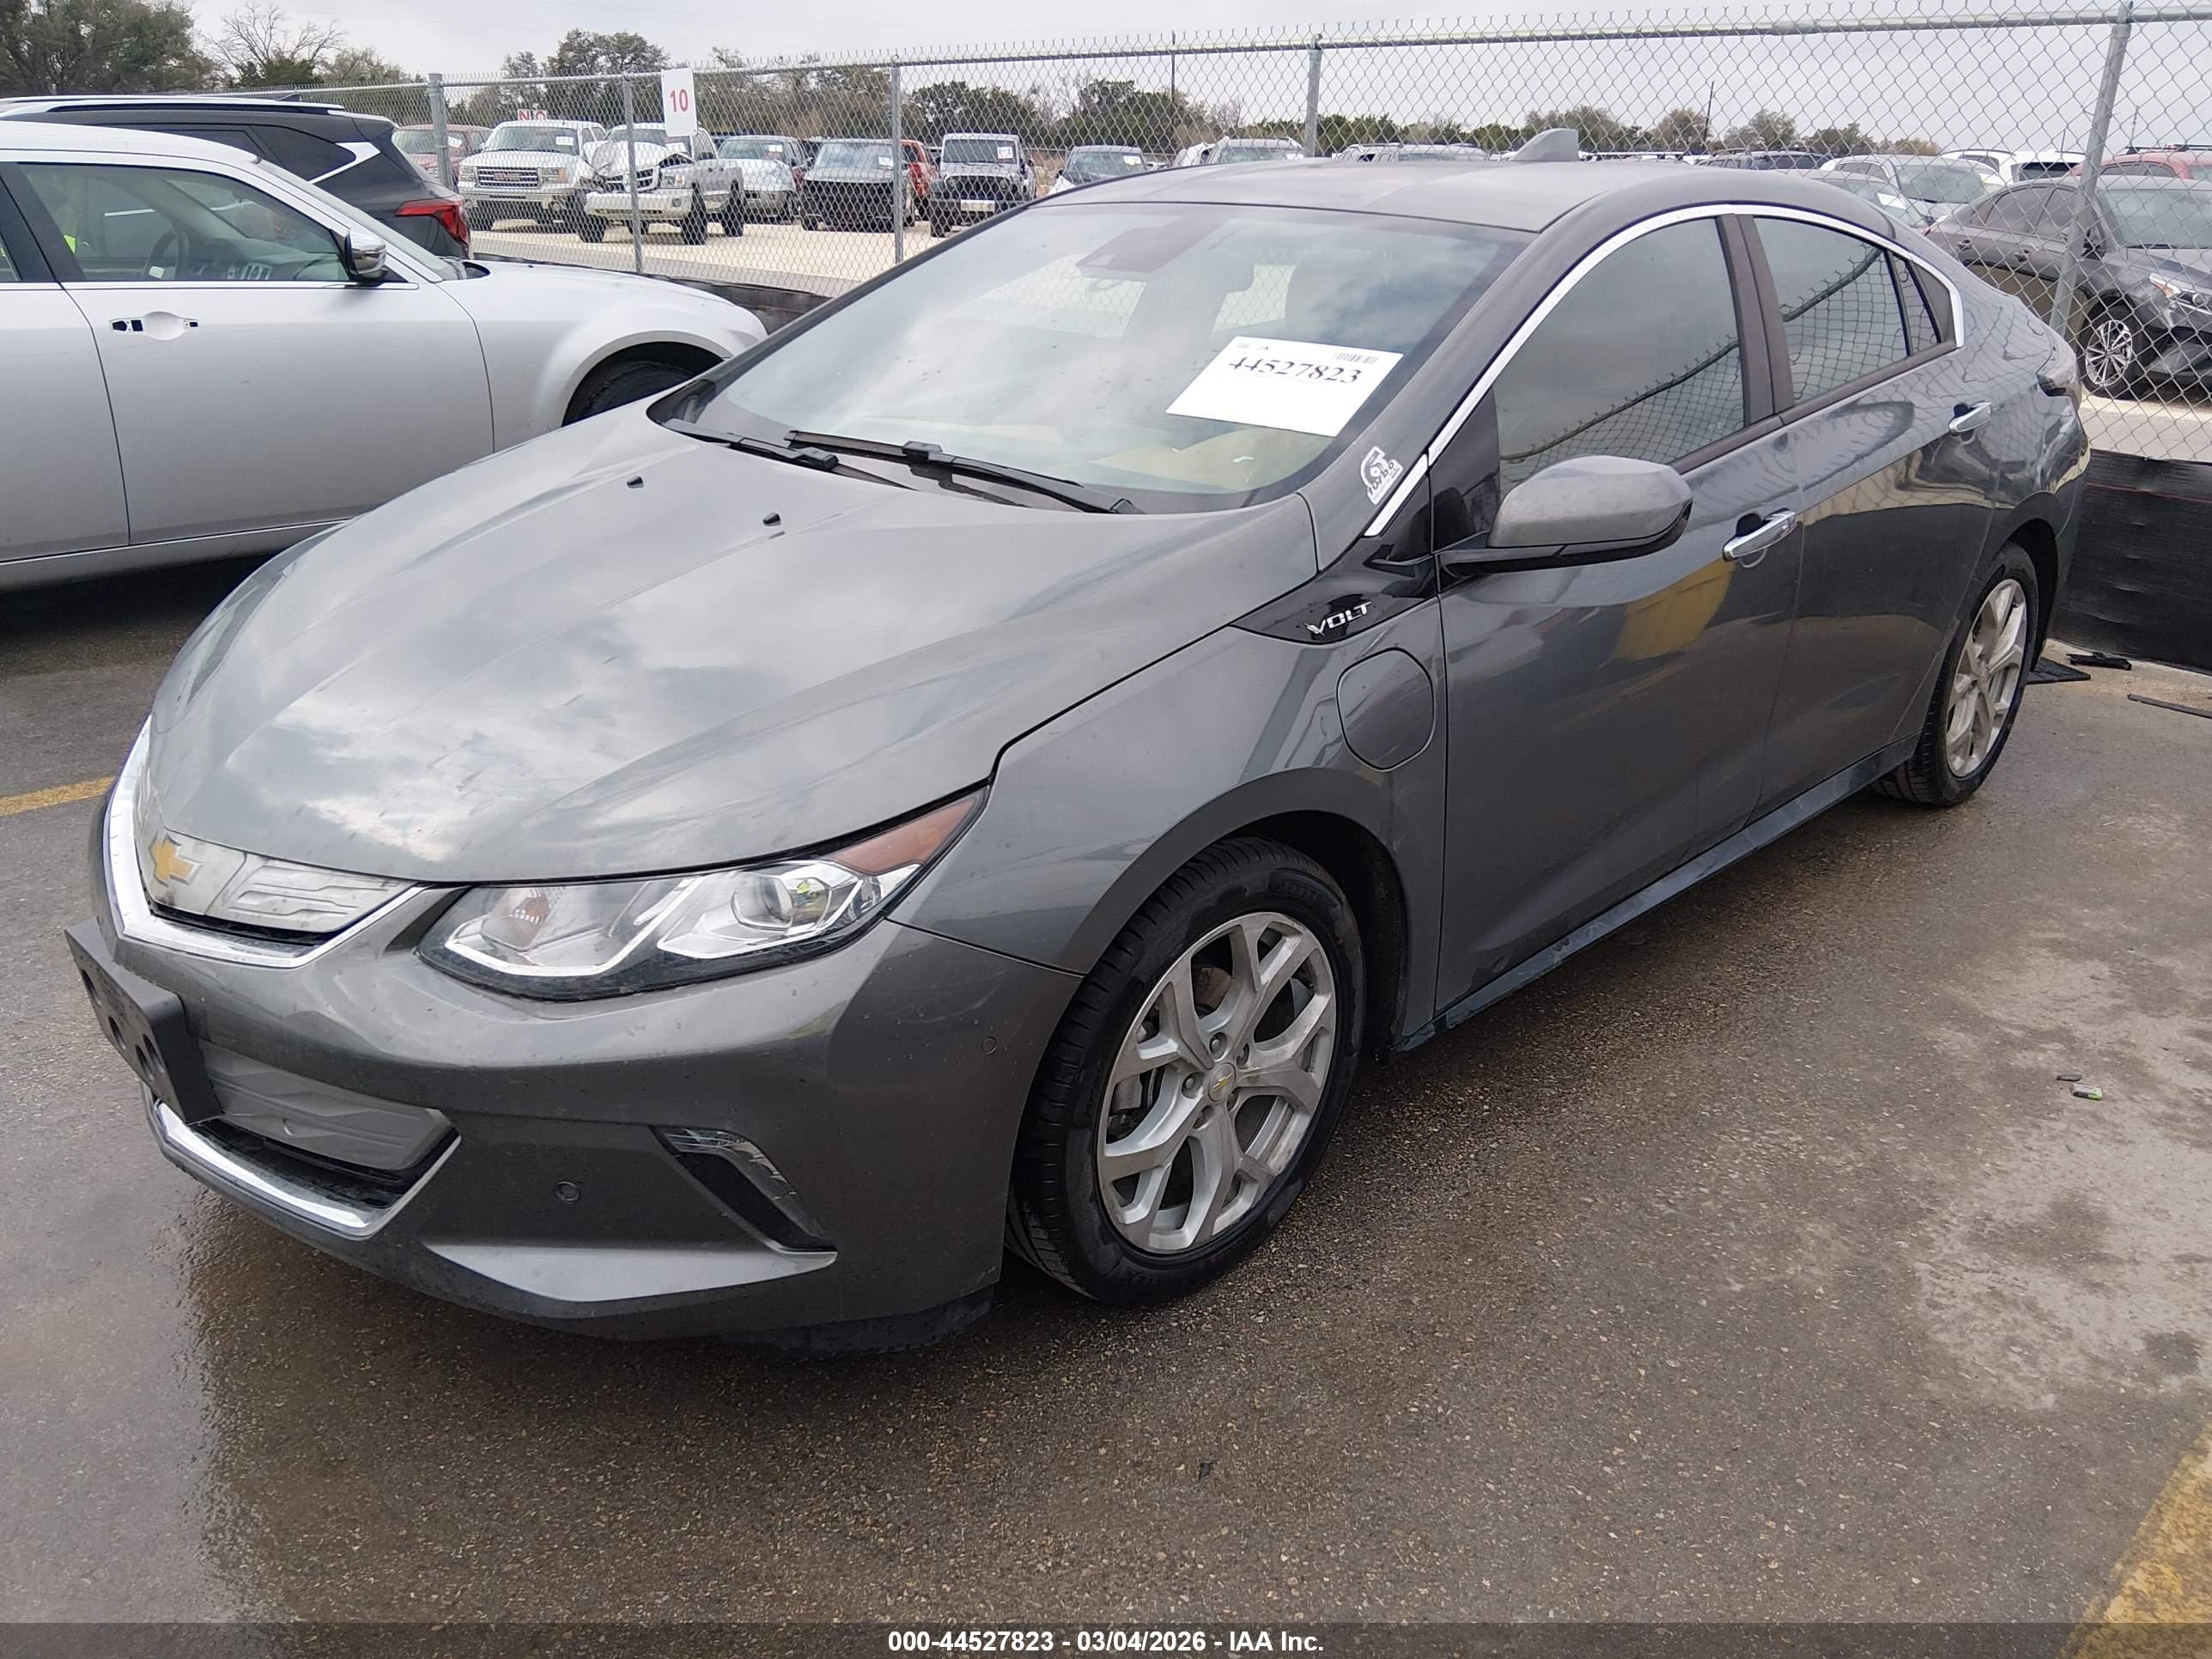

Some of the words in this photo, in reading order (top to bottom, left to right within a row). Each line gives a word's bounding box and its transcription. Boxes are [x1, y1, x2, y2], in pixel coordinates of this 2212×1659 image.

[670, 88, 689, 112] 10
[1227, 356, 1363, 383] 44527823
[1304, 600, 1372, 636] VOLT
